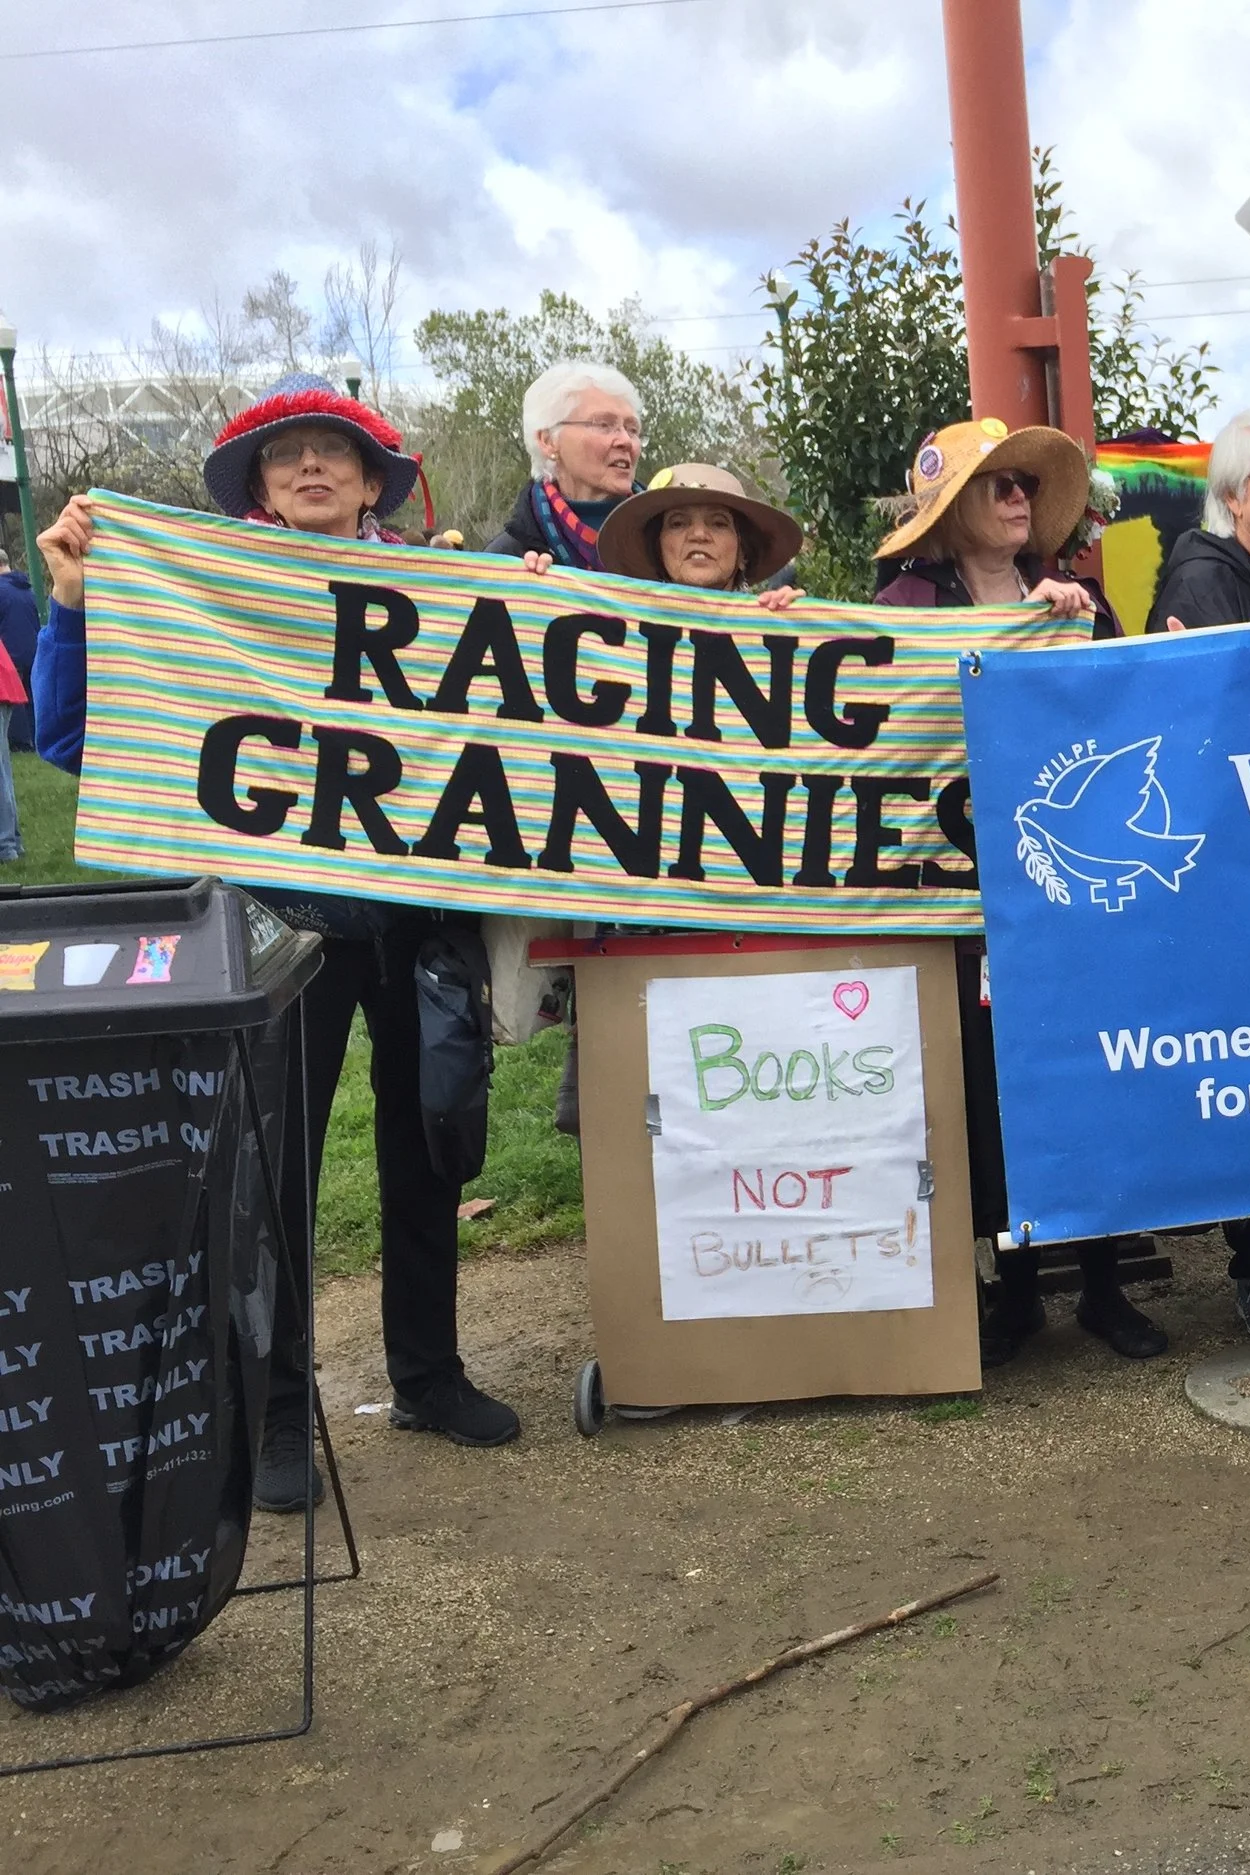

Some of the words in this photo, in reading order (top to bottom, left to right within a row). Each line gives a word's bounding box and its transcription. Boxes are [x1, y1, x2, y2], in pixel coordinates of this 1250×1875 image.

[324, 579, 894, 749] RAGING
[1033, 739, 1098, 787] WILPF
[27, 1067, 161, 1102] TRASH
[39, 1121, 170, 1158] TRASH
[732, 1166, 853, 1213] NOT
[690, 1207, 918, 1278] BULLETS!
[0, 1490, 74, 1517] cling.com
